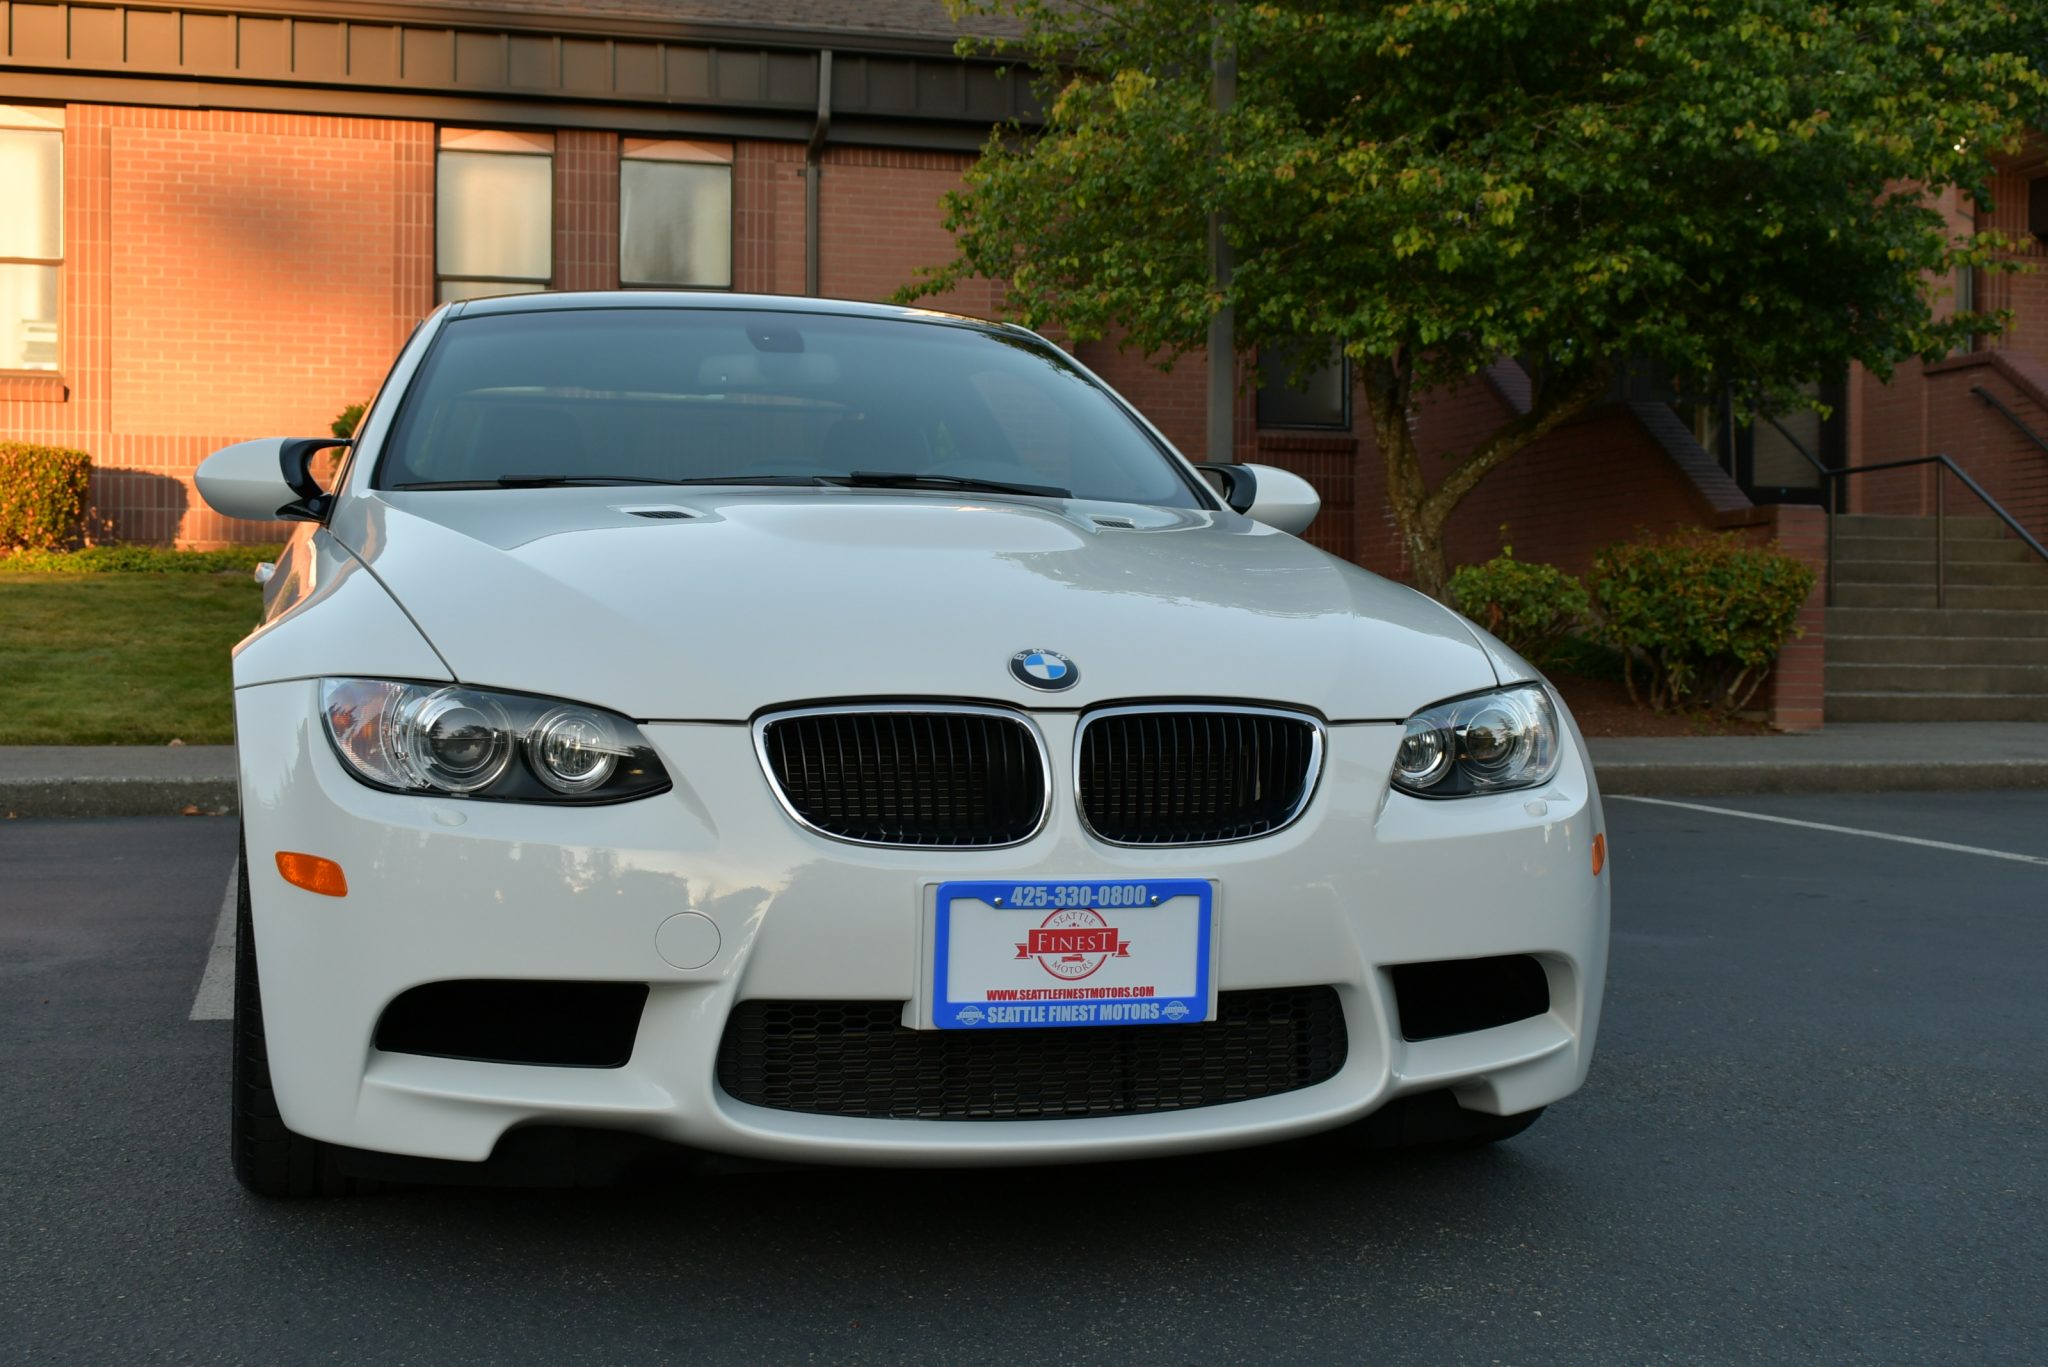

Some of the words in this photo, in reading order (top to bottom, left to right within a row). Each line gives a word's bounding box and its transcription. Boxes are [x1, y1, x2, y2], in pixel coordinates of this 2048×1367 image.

[1010, 885, 1147, 907] 425-330-0800
[1053, 911, 1096, 927] SEATTLE
[1037, 931, 1112, 952] FINEST
[1051, 959, 1095, 975] MOTORS
[986, 986, 1155, 1001] WWW.SEATTLEFINESTMOTORS.COM
[987, 1006, 1046, 1023] SEATTLE
[1049, 1004, 1097, 1022] FINEST
[1100, 1003, 1160, 1021] MOTORS
